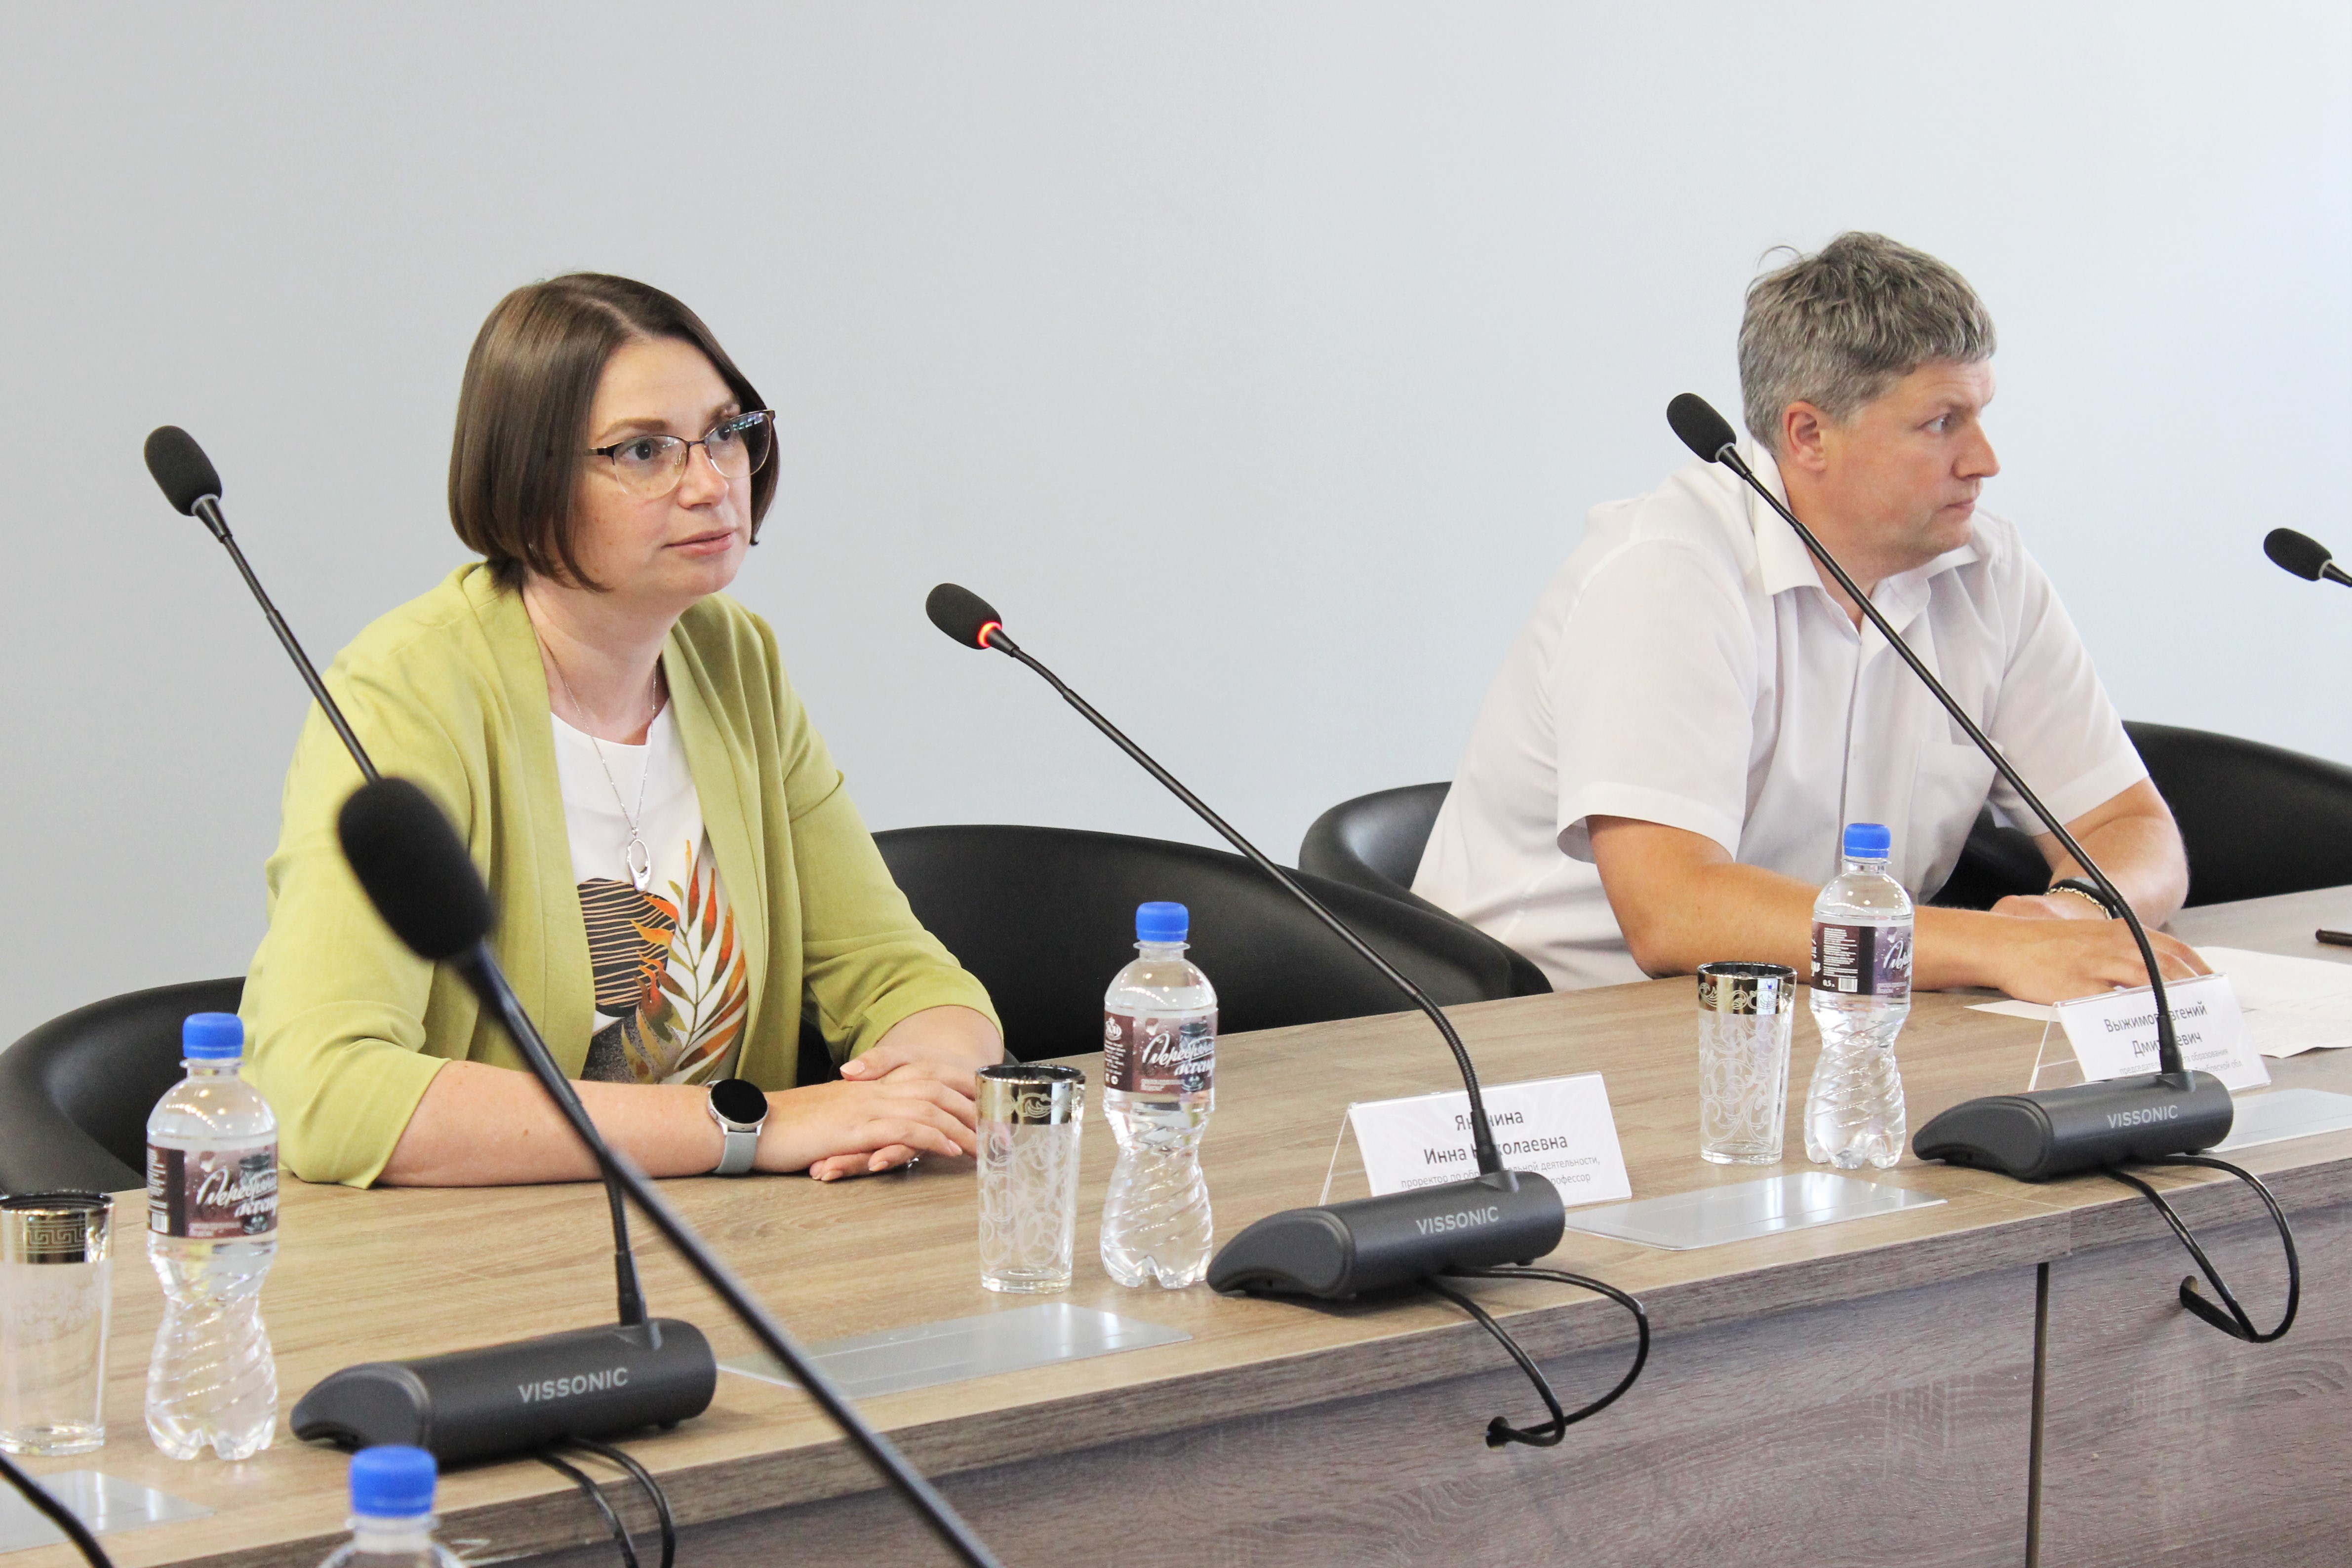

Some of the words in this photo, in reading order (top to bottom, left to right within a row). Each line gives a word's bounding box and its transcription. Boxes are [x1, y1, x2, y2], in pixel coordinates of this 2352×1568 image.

[2168, 1001, 2208, 1021] вгений
[2132, 1031, 2202, 1058] Дмиевич
[2192, 1048, 2229, 1062] образования
[2107, 1105, 2179, 1129] VISSONIC
[1424, 1148, 1467, 1165] Инна
[1471, 1136, 1568, 1159] Нолаевна
[1401, 1175, 1449, 1188] проректор
[1450, 1174, 1462, 1183] по
[1541, 1156, 1600, 1172] деятельности,
[1551, 1173, 1592, 1187] рофессор
[1415, 1206, 1499, 1235] VISSONIC
[518, 1367, 629, 1404] VISSONIC
